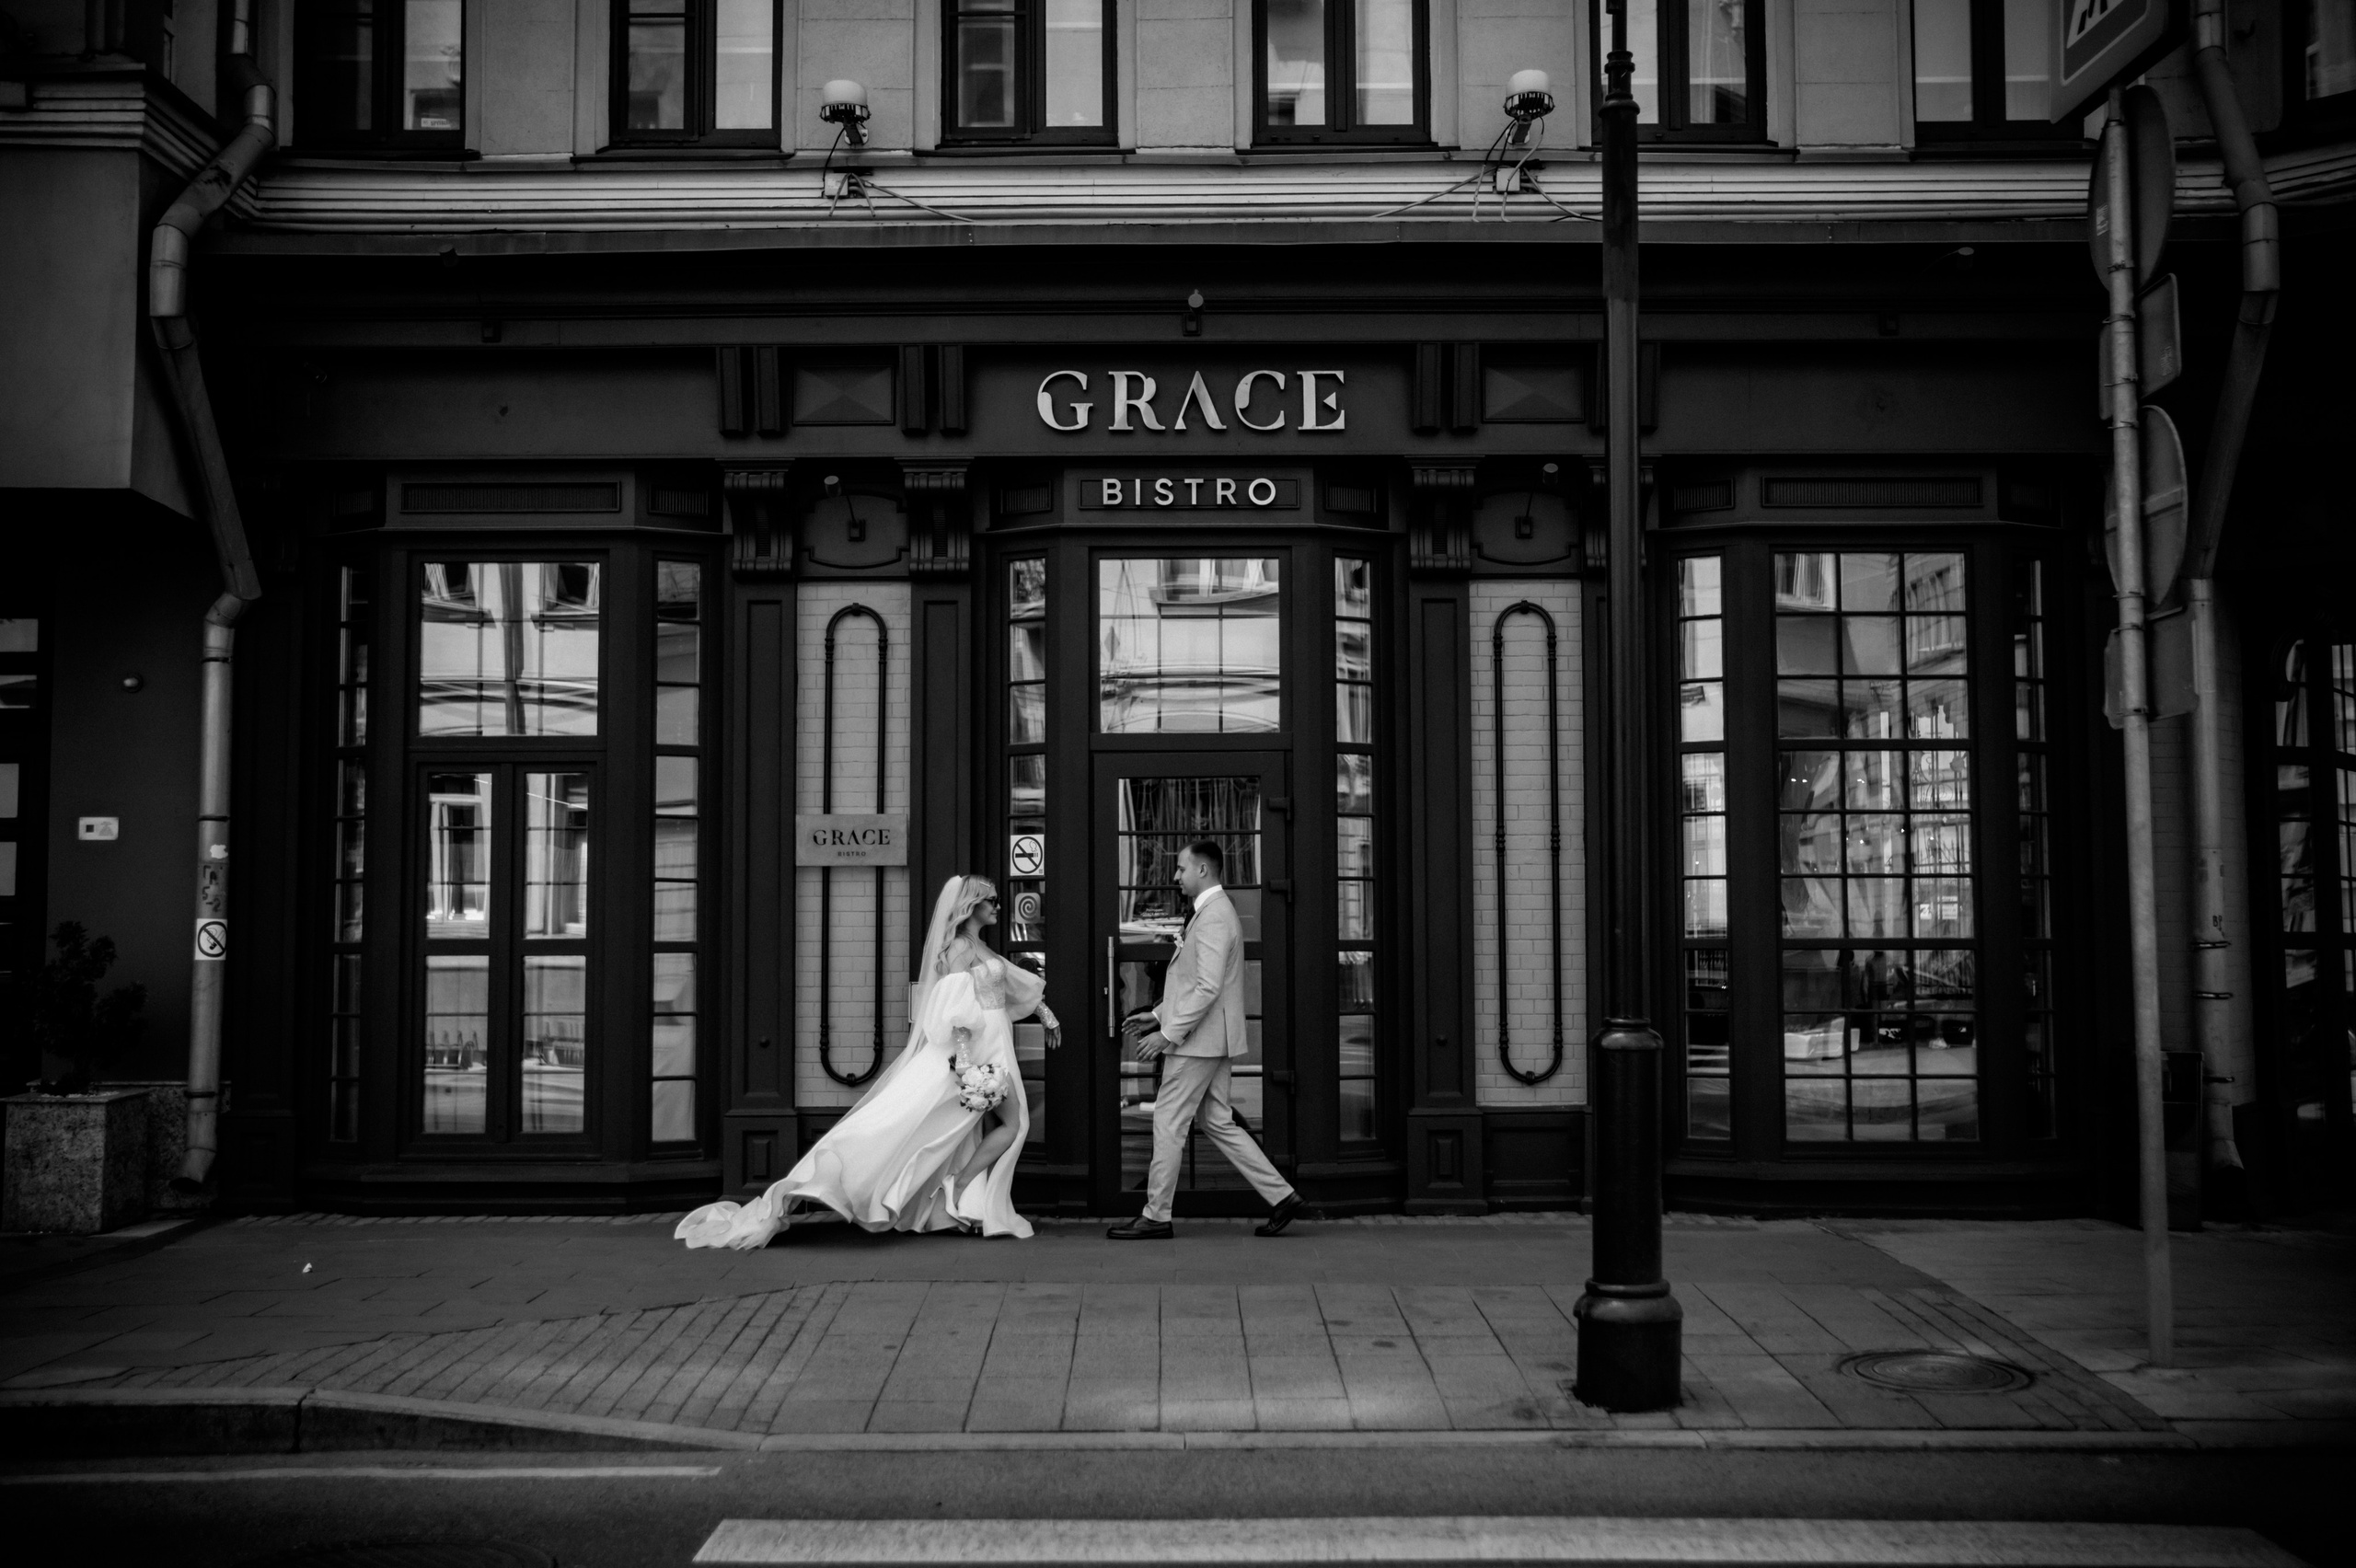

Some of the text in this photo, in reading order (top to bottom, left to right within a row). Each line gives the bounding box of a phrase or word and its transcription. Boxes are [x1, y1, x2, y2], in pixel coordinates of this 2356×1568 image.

[1036, 370, 1345, 431] GRACE
[1102, 478, 1276, 506] BISTRO
[813, 829, 891, 846] GRACE
